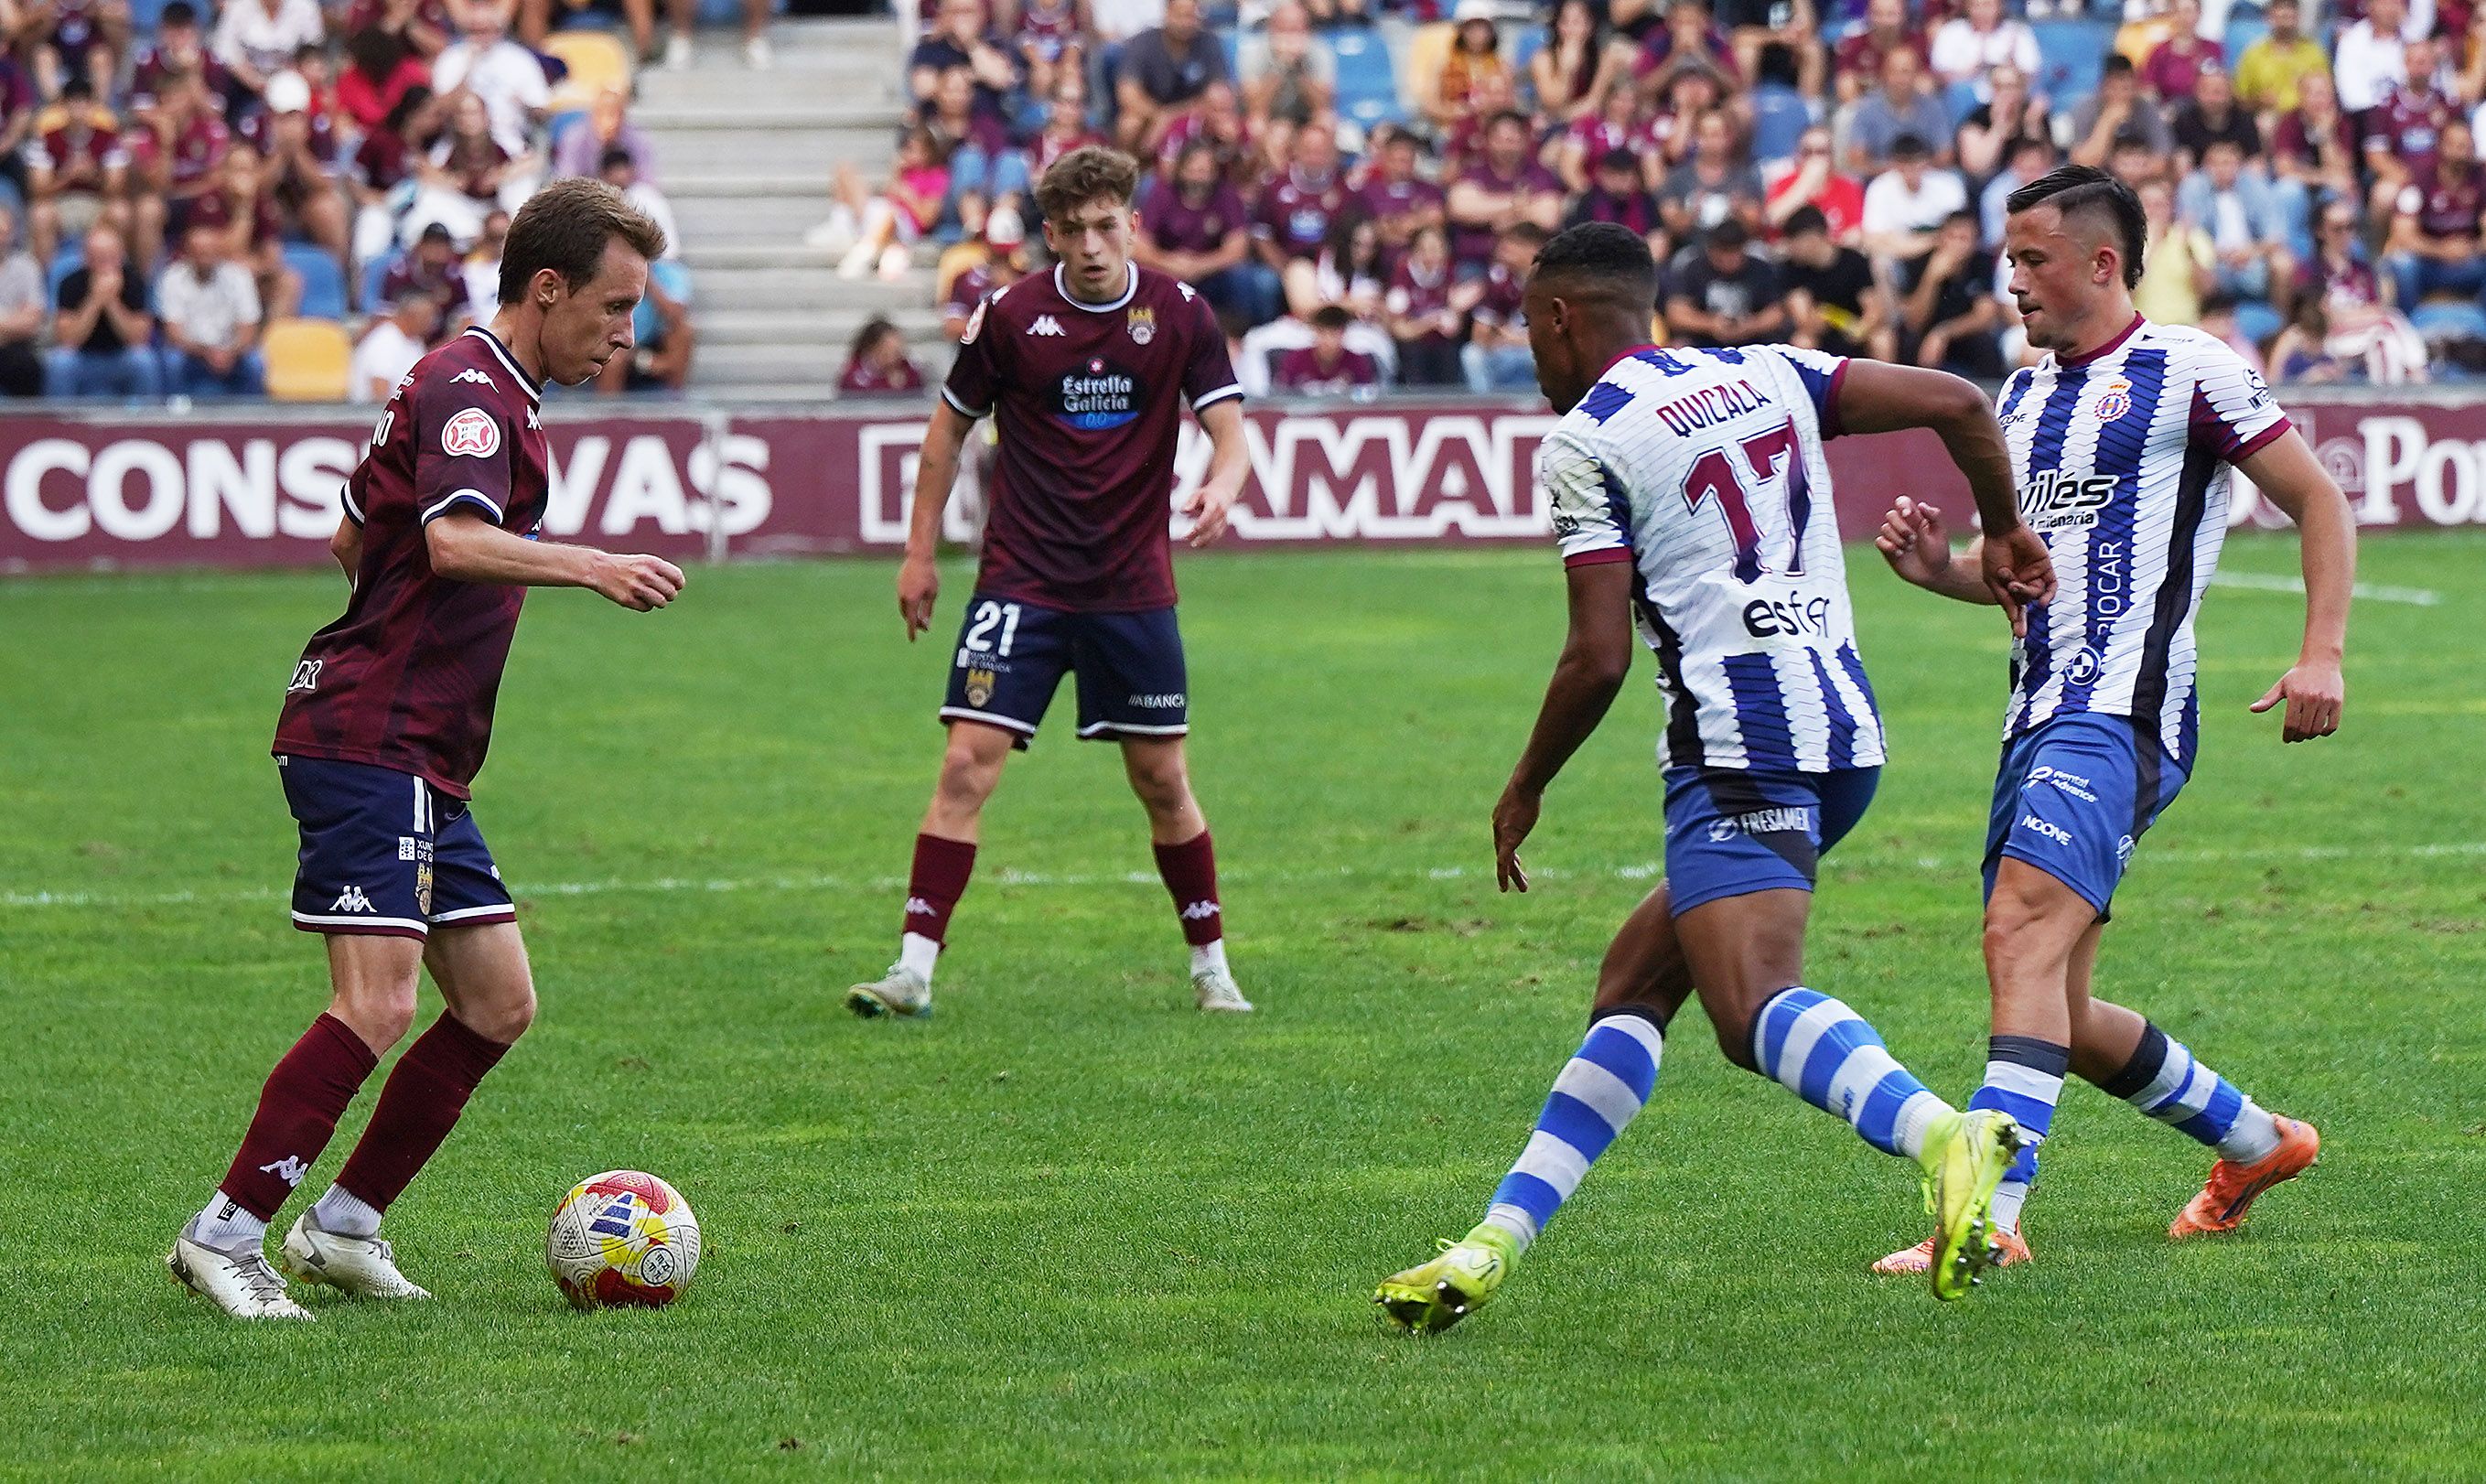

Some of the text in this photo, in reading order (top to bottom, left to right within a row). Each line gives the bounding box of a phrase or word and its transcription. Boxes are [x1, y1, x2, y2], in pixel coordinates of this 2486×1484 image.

[1062, 374, 1134, 394] Estrella
[1063, 393, 1130, 413] Galicia
[5, 435, 774, 543] CONSVAS
[1679, 408, 1813, 587] 17
[965, 600, 1022, 657] 21
[2021, 814, 2072, 846] NOONE
